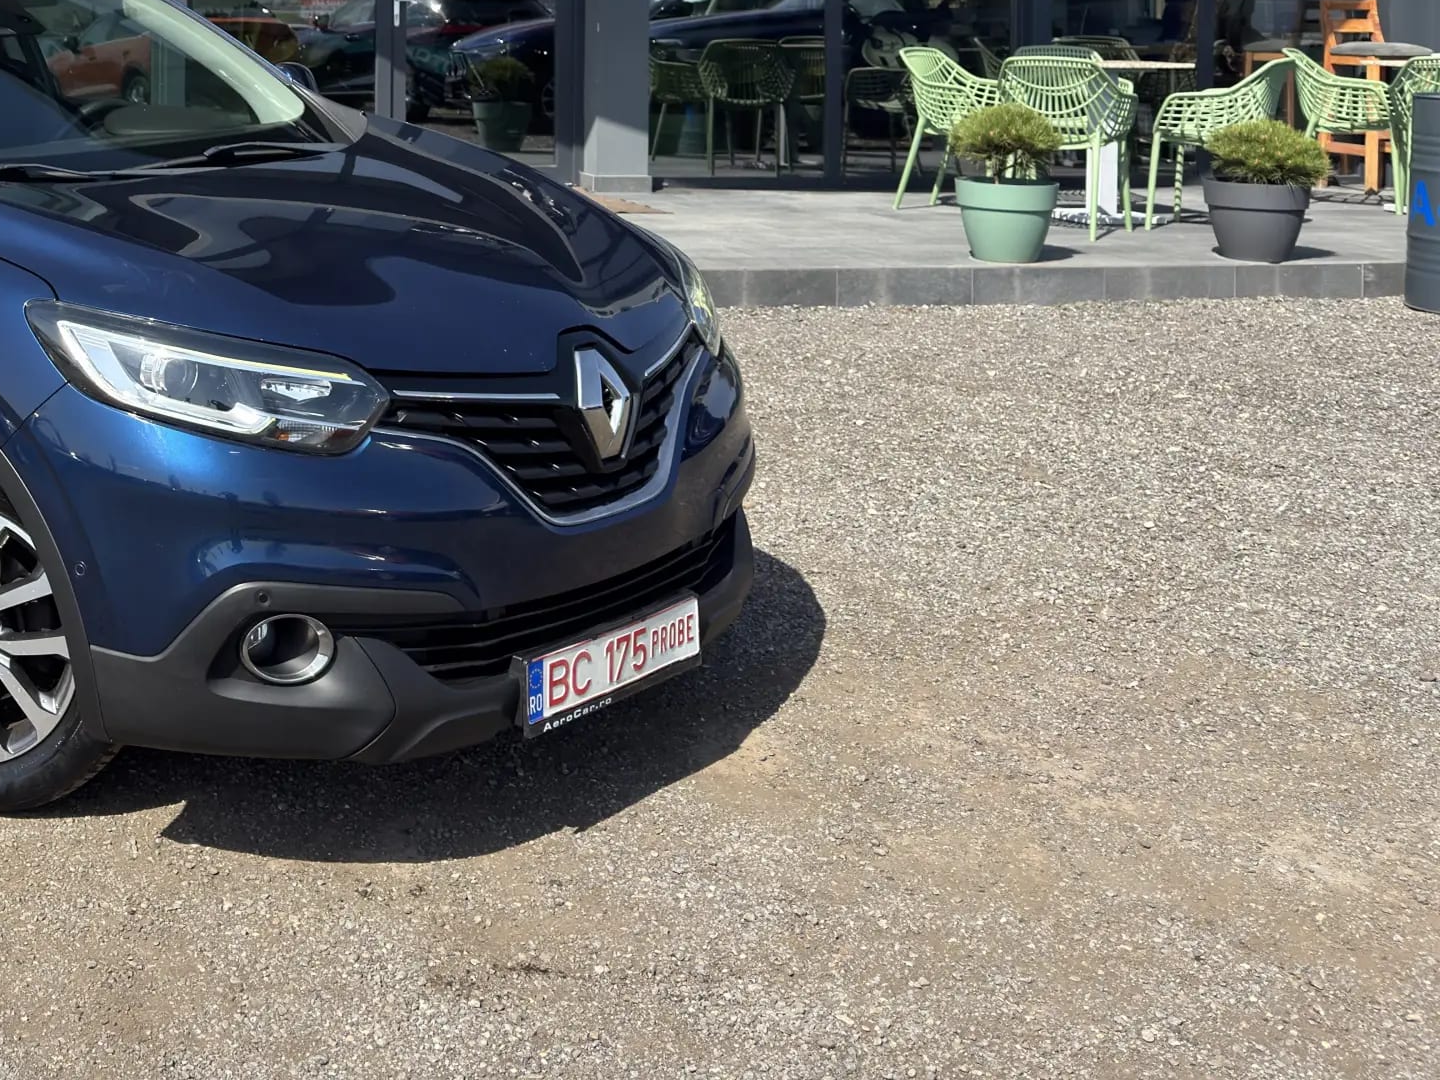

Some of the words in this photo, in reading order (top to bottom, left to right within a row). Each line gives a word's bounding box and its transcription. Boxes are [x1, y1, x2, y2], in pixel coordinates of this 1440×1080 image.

[547, 649, 592, 709] BC
[603, 627, 647, 684] 175
[651, 614, 695, 658] PROBE
[529, 694, 543, 715] RO
[543, 697, 613, 732] AeroCar.ro
